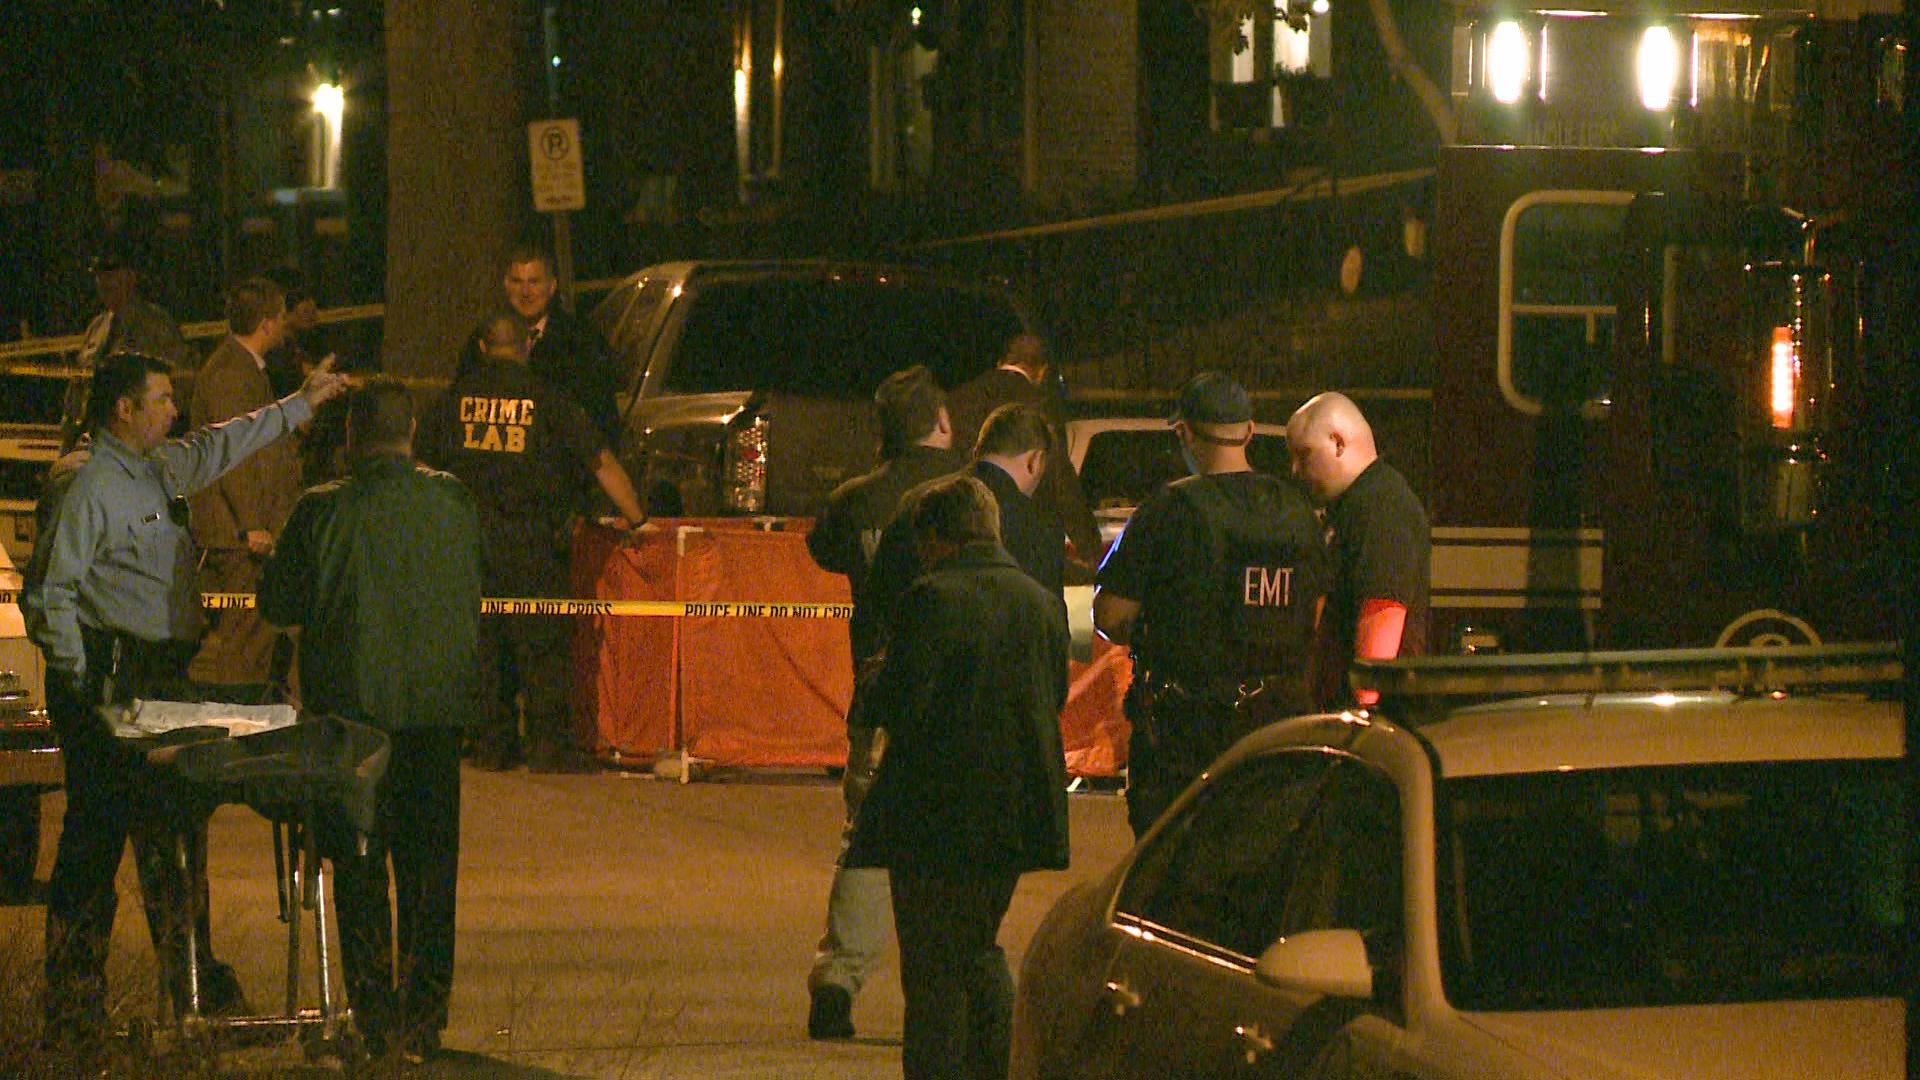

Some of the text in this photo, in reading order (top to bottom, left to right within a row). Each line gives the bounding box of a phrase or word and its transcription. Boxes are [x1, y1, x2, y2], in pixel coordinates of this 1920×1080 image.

[460, 396, 534, 426] CRIME
[464, 423, 525, 453] LAB
[1244, 567, 1294, 606] EMT
[513, 602, 531, 615] DO
[535, 602, 563, 616] NOT
[566, 602, 614, 616] CROSS
[684, 603, 851, 619] POLICE LINE DO NOT CRO
